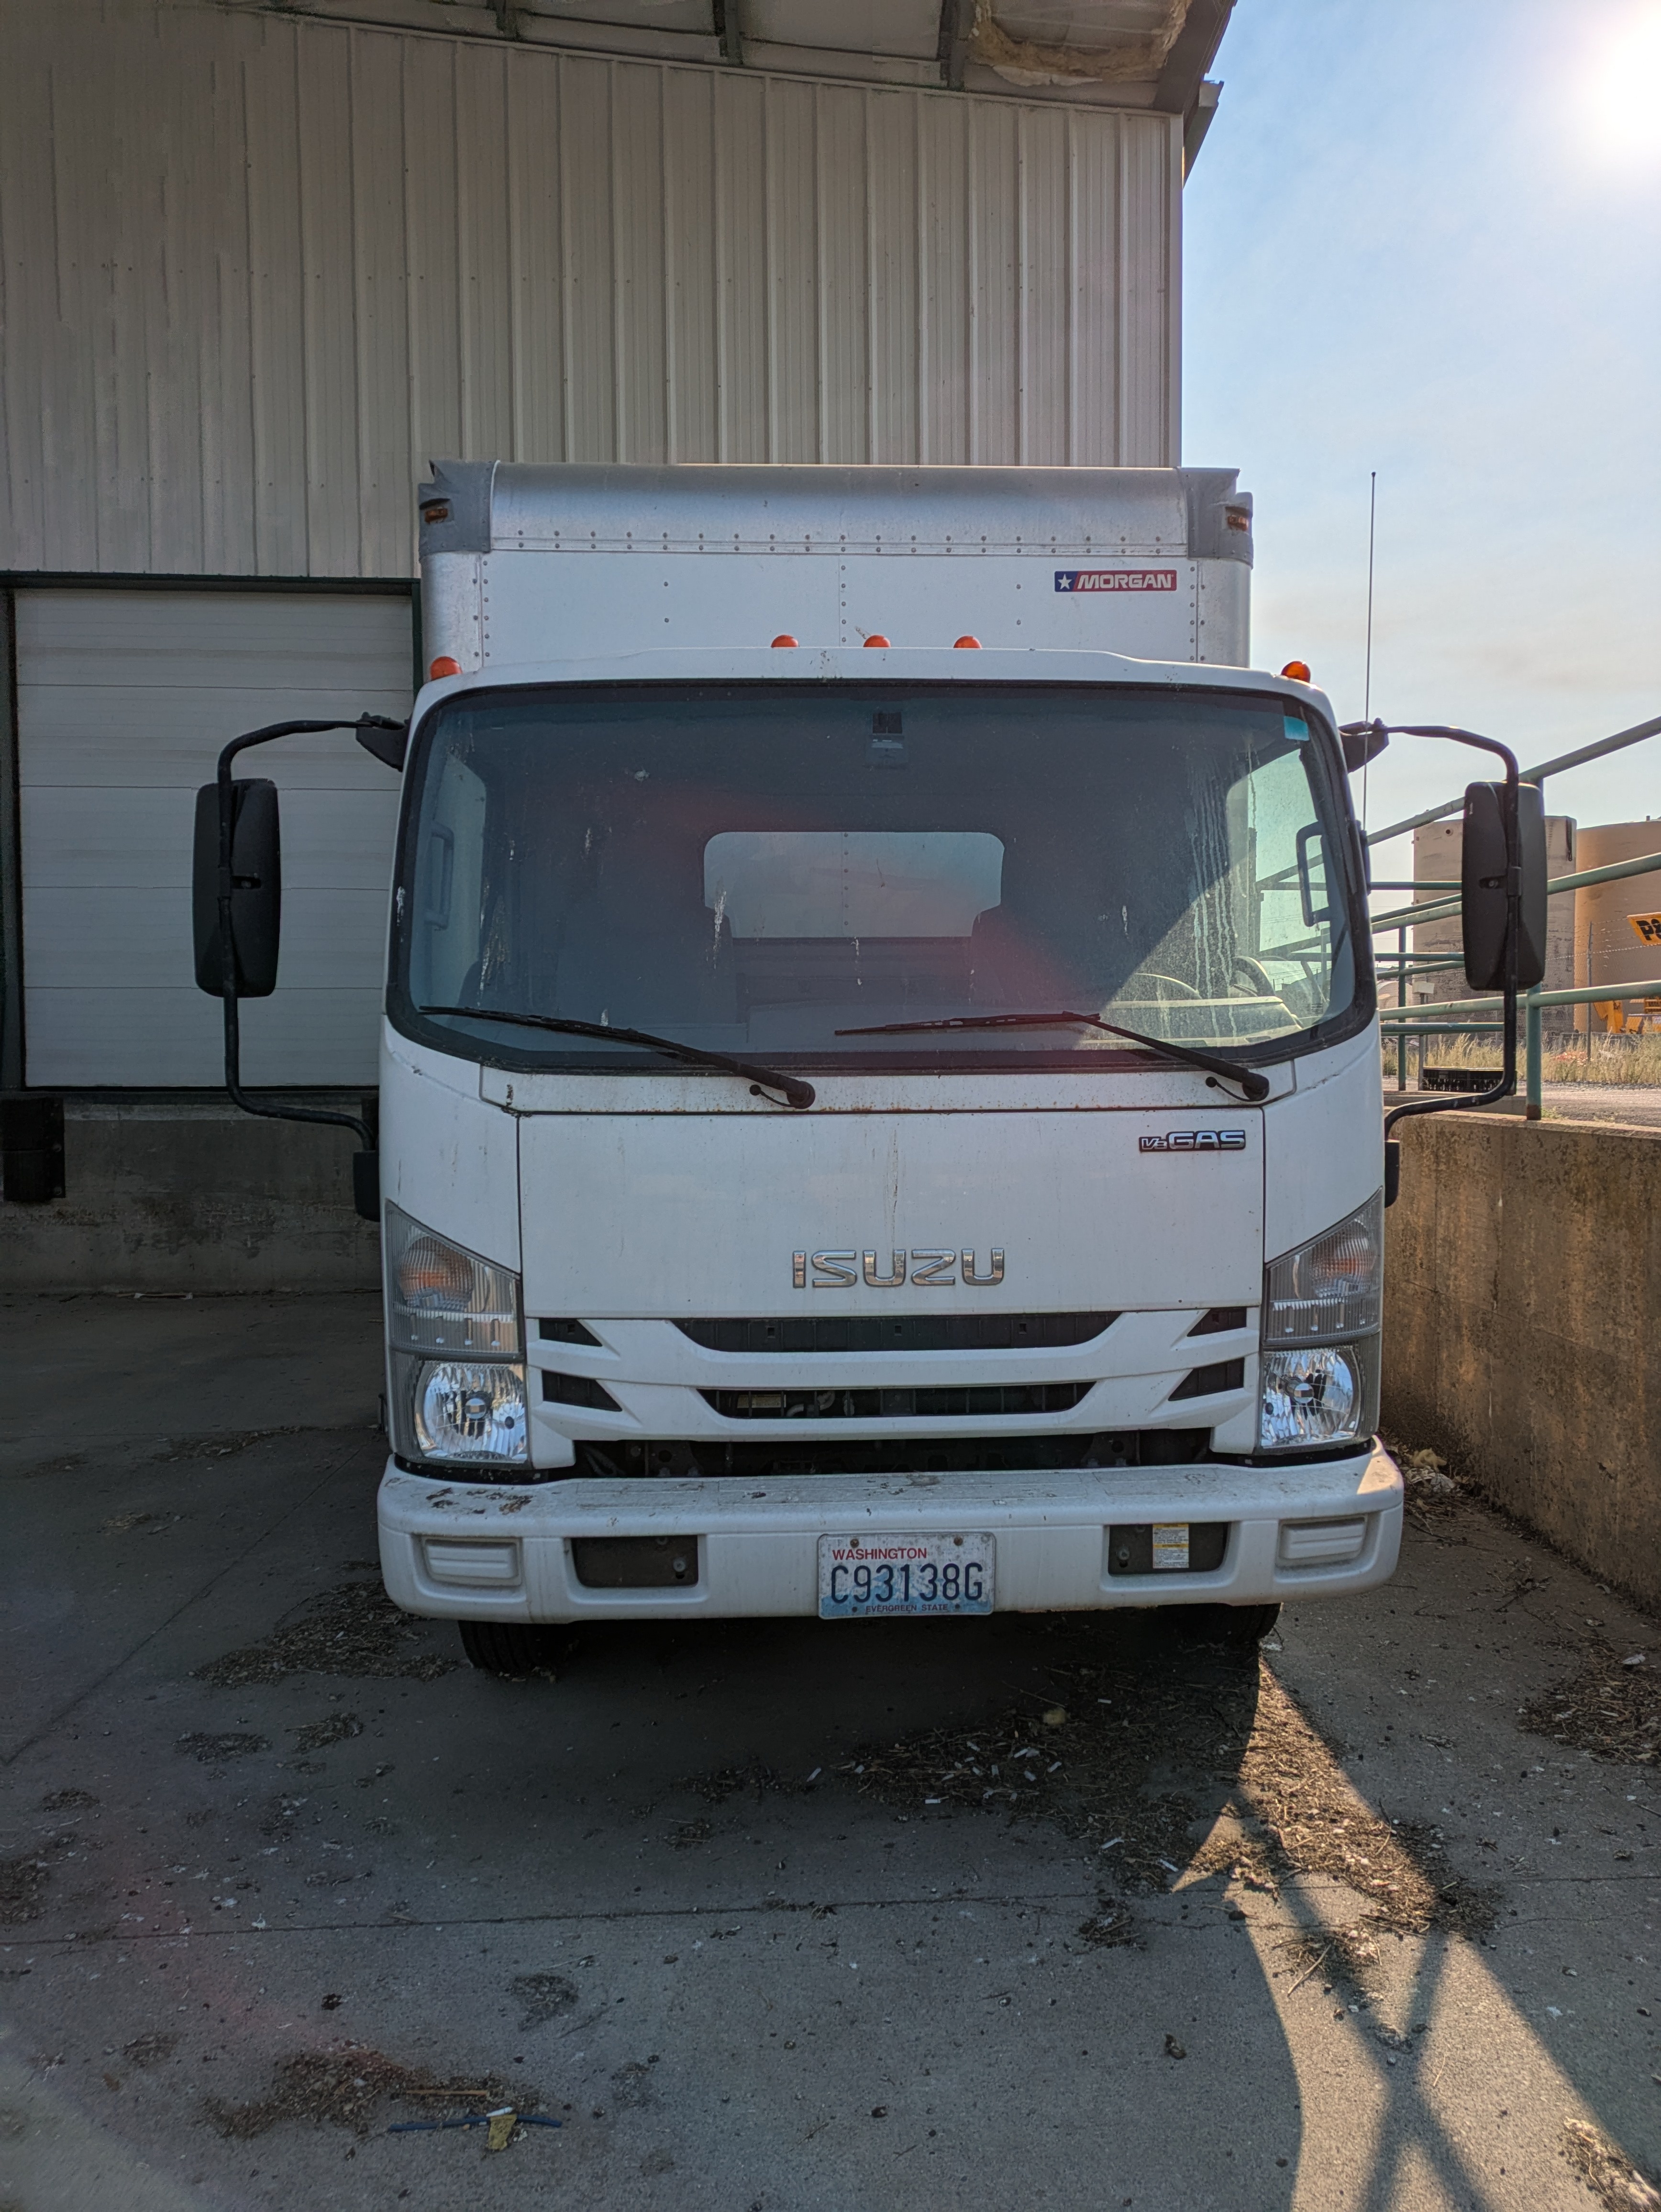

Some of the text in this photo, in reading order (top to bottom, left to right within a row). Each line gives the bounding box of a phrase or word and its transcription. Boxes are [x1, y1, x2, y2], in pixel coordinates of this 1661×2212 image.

[1077, 574, 1171, 589] MORGAN
[792, 1248, 1005, 1288] ISUZU
[832, 1548, 927, 1560] WASHINGTON
[830, 1562, 983, 1604] C93138G
[865, 1605, 917, 1613] EVERGREEN
